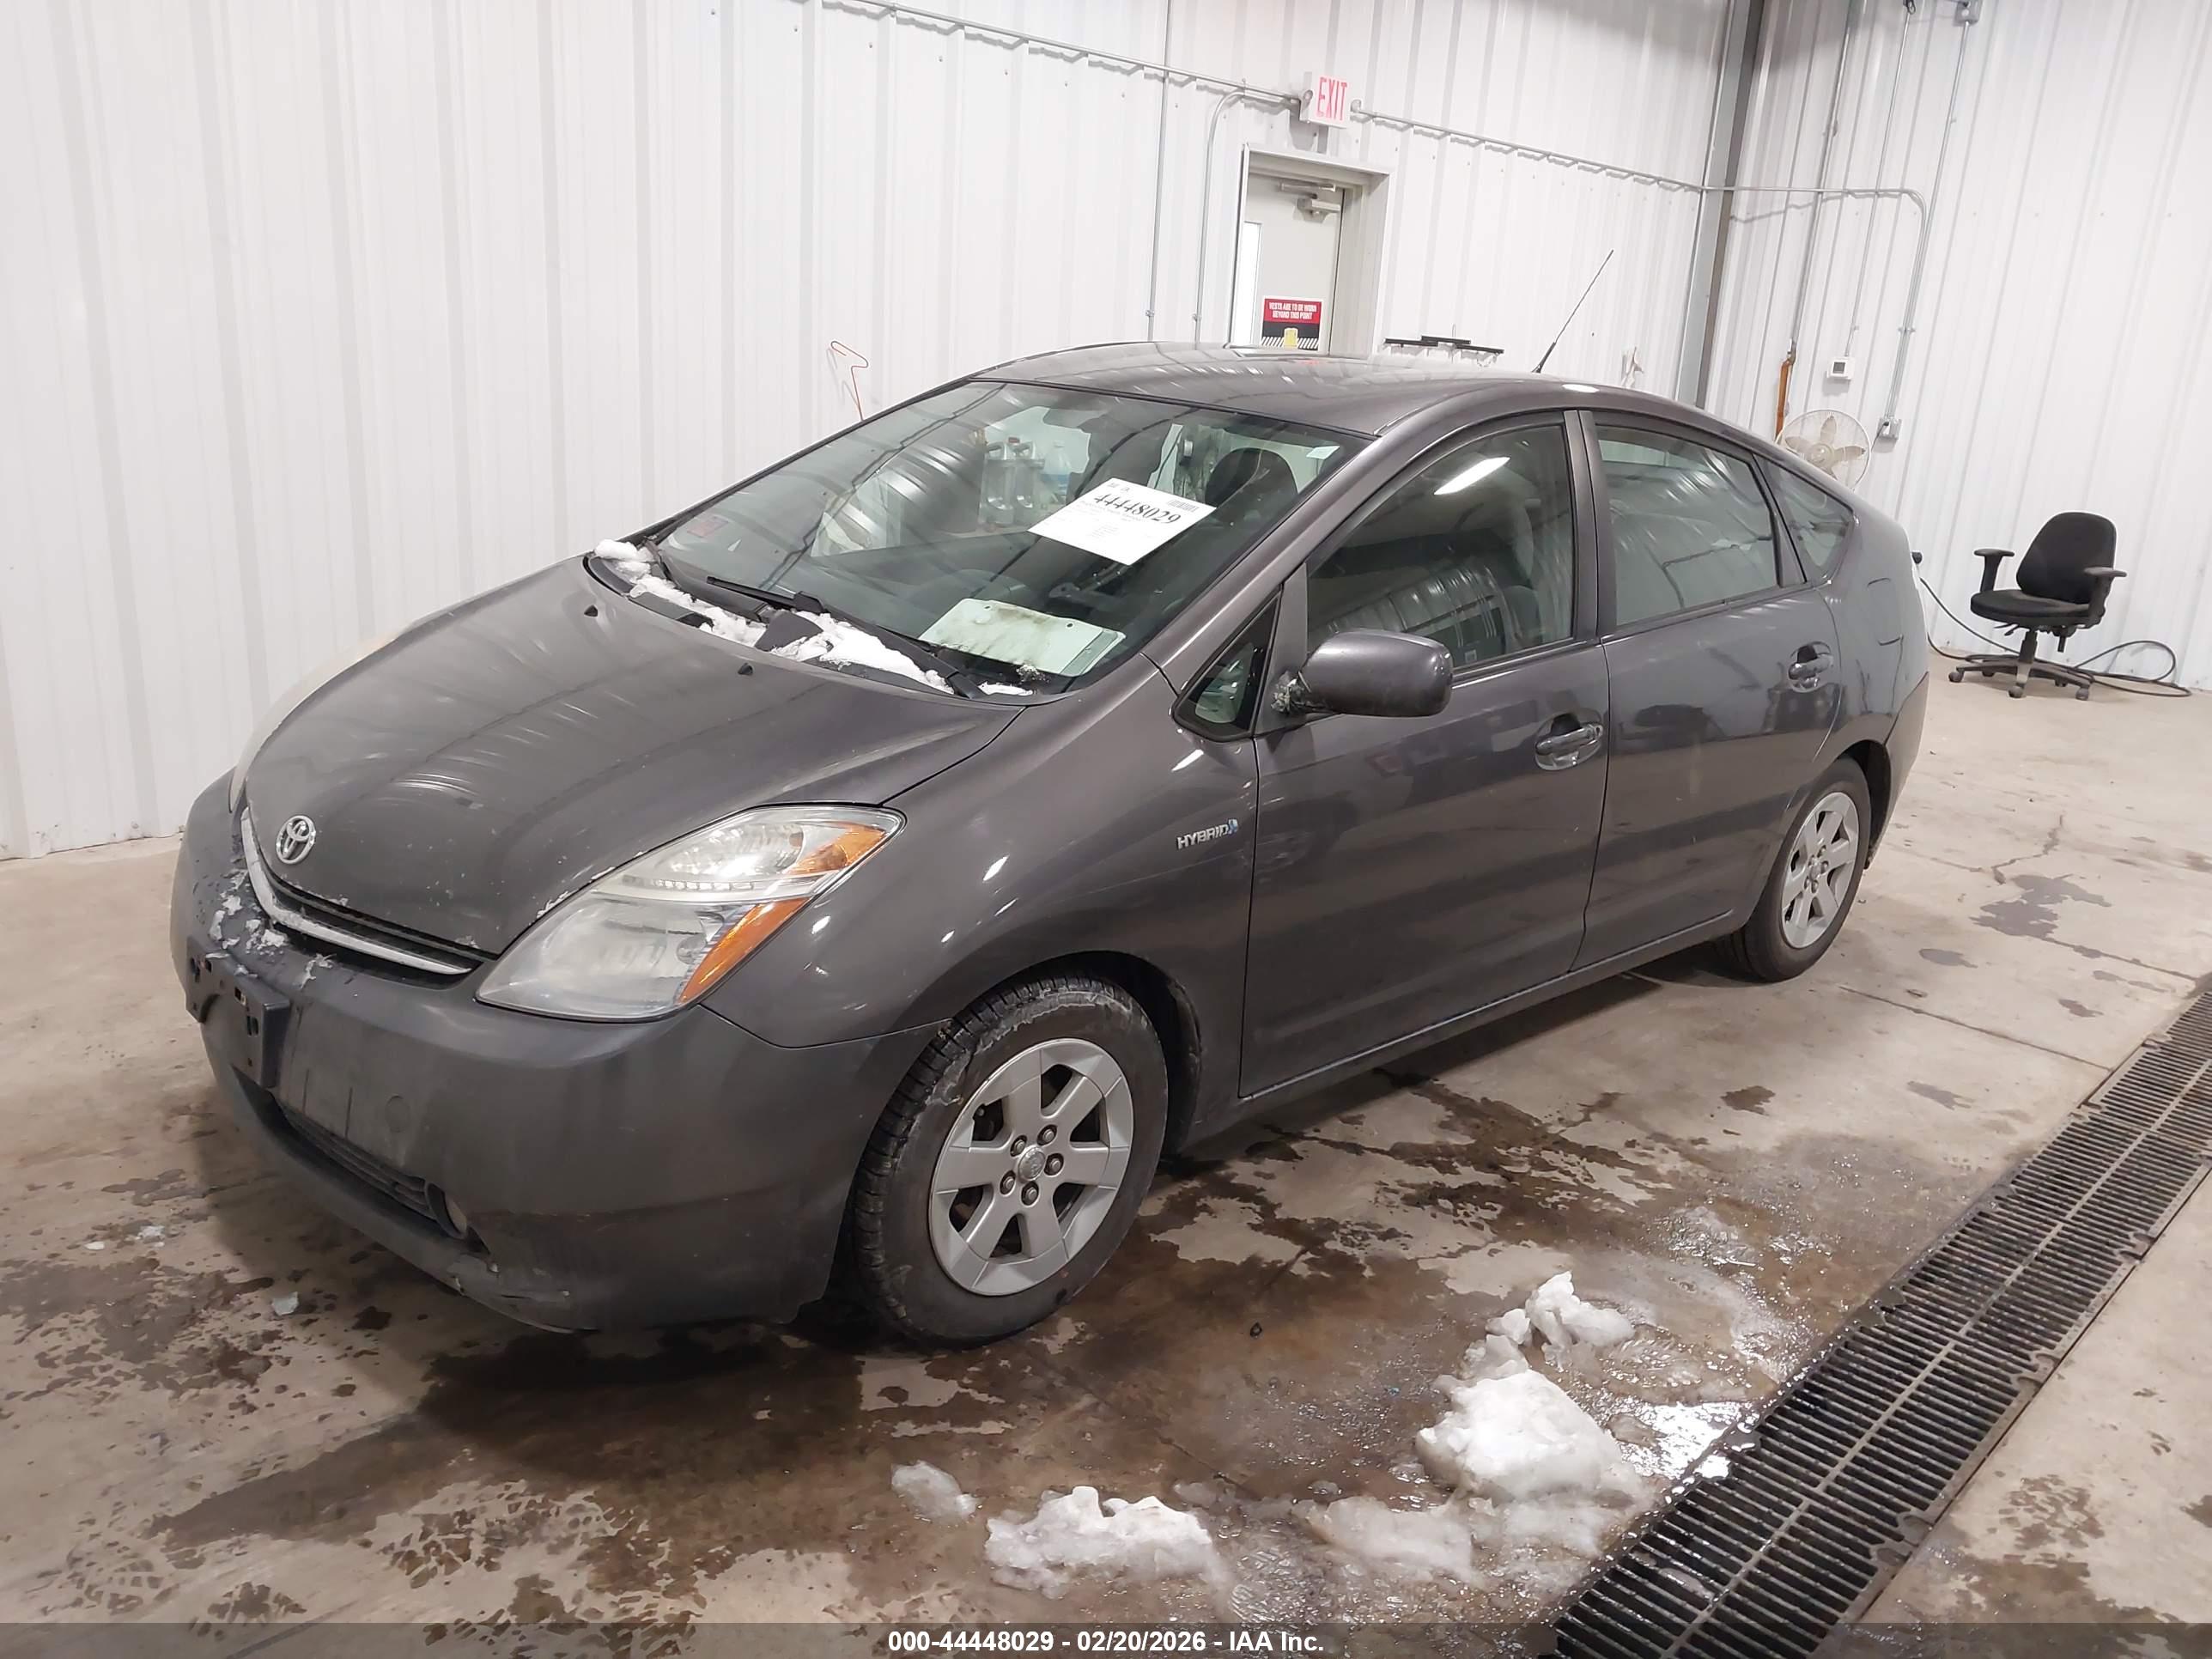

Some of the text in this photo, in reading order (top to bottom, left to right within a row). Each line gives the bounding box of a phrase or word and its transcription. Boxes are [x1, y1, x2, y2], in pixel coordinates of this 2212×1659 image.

[1316, 76, 1347, 120] EXIT
[1272, 310, 1290, 319] BEYOND
[1283, 302, 1291, 311] ARE
[1094, 492, 1182, 524] 44448029
[1177, 824, 1229, 849] HYBRID
